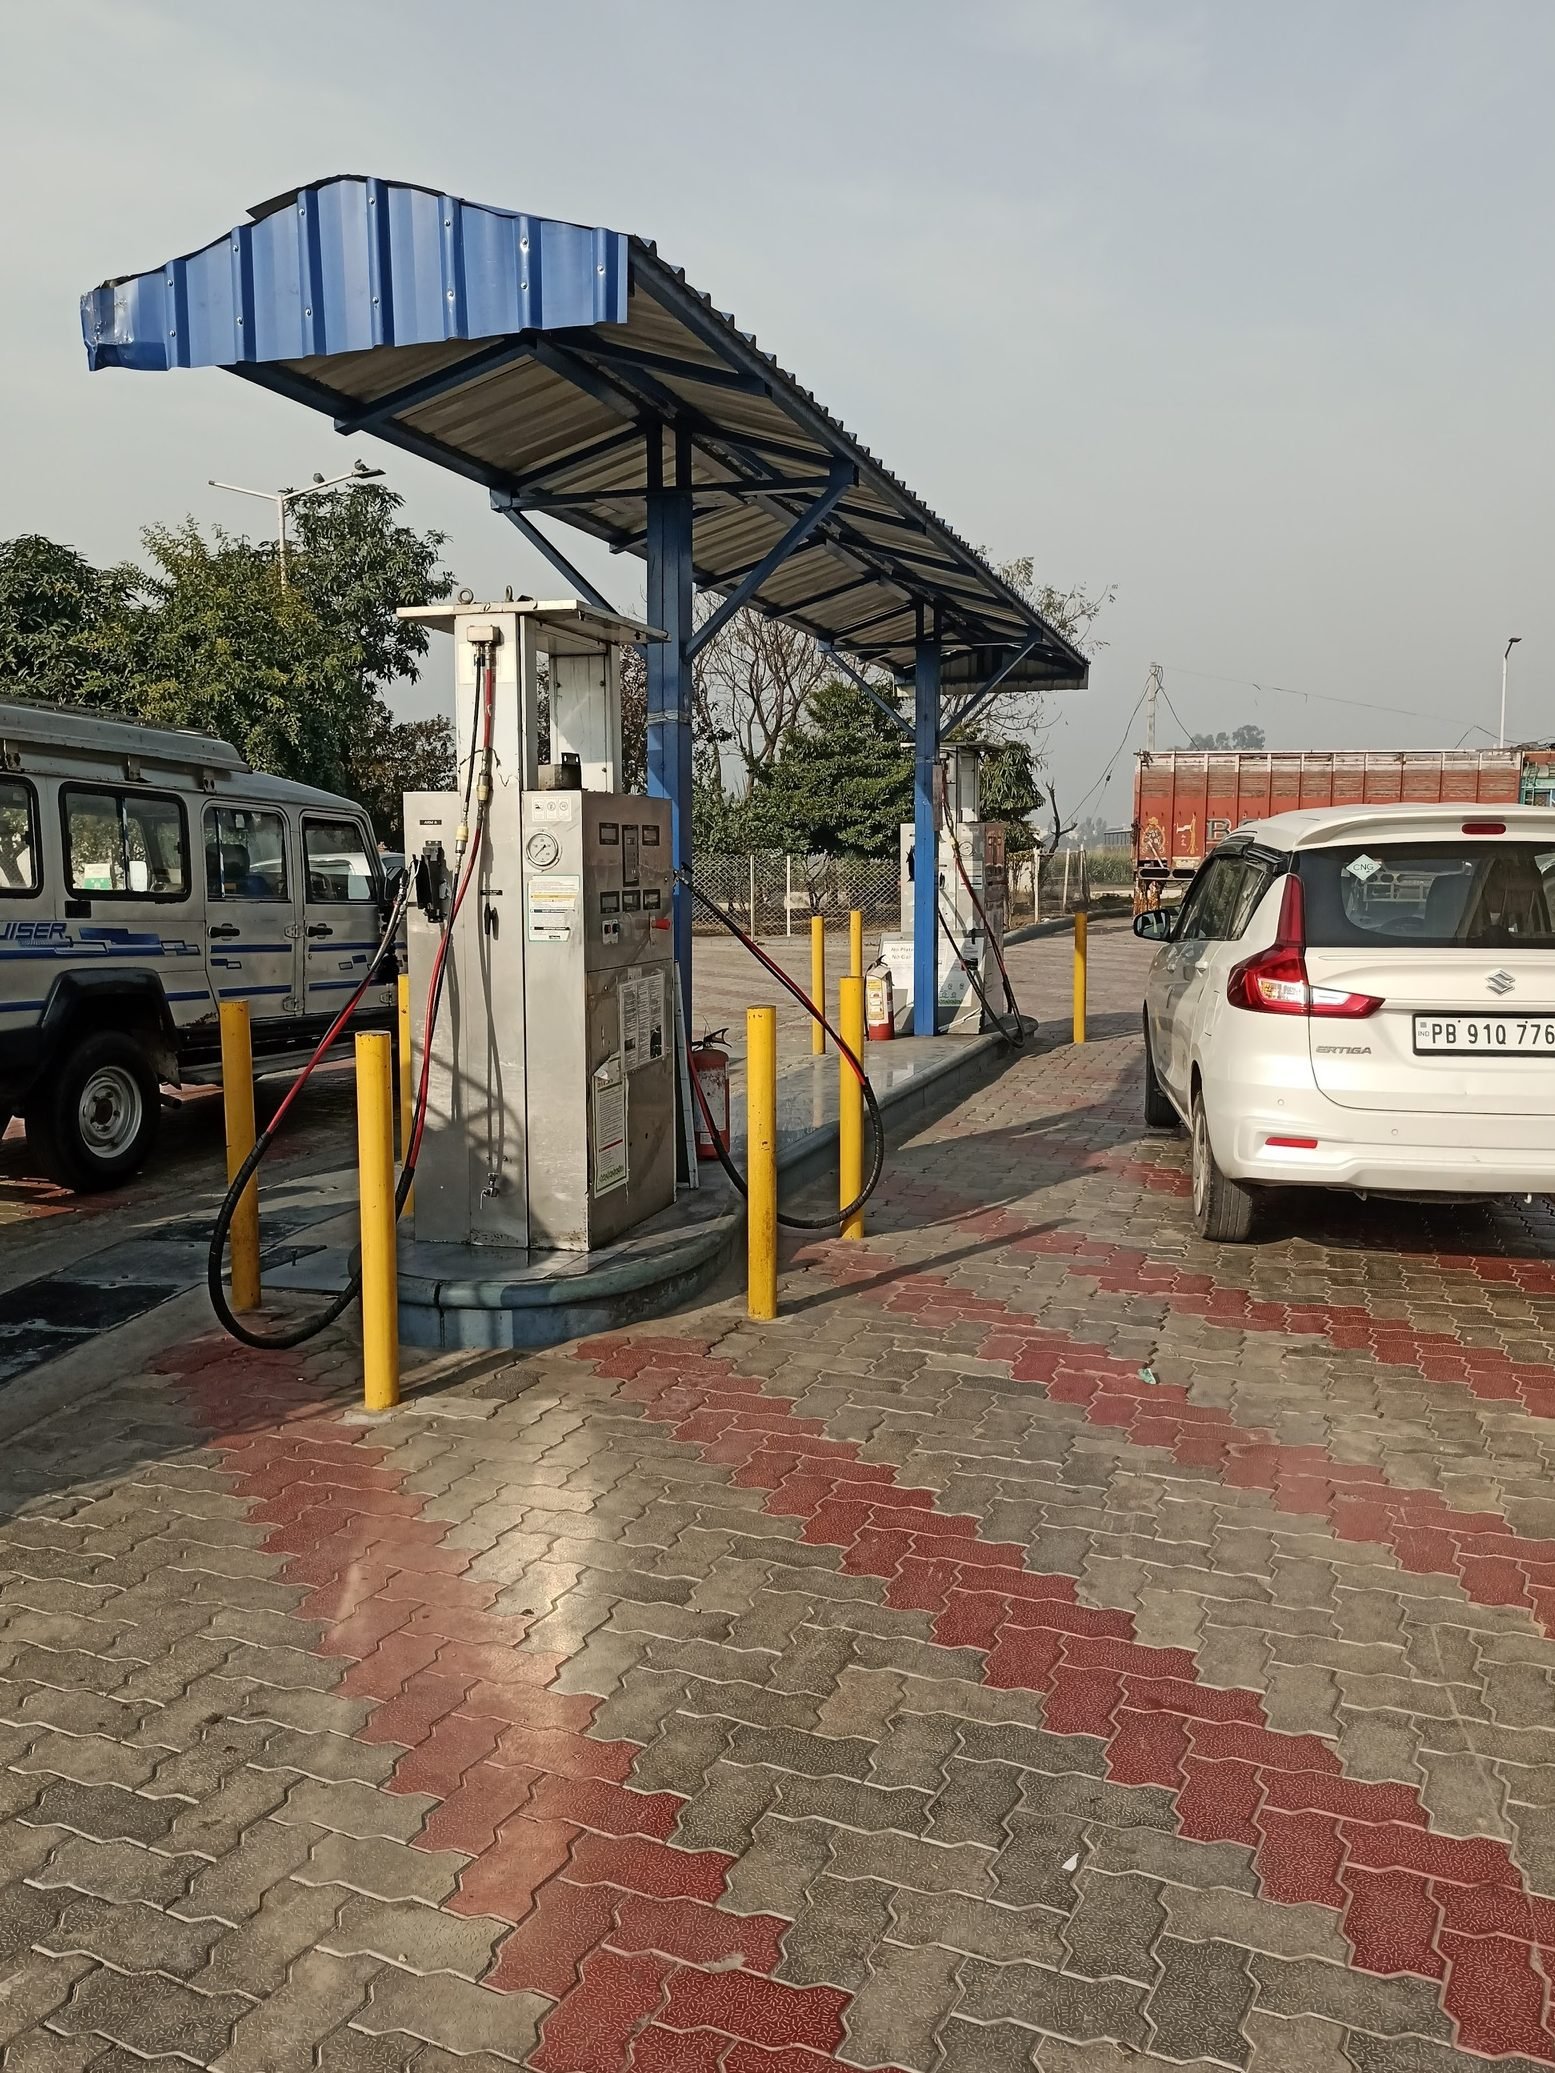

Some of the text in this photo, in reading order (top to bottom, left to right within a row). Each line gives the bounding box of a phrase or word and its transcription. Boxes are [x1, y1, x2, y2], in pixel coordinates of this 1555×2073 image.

[1353, 863, 1374, 871] CNG
[1431, 1023, 1555, 1045] PB 91Q 776
[1315, 1045, 1372, 1055] ERTIGA
